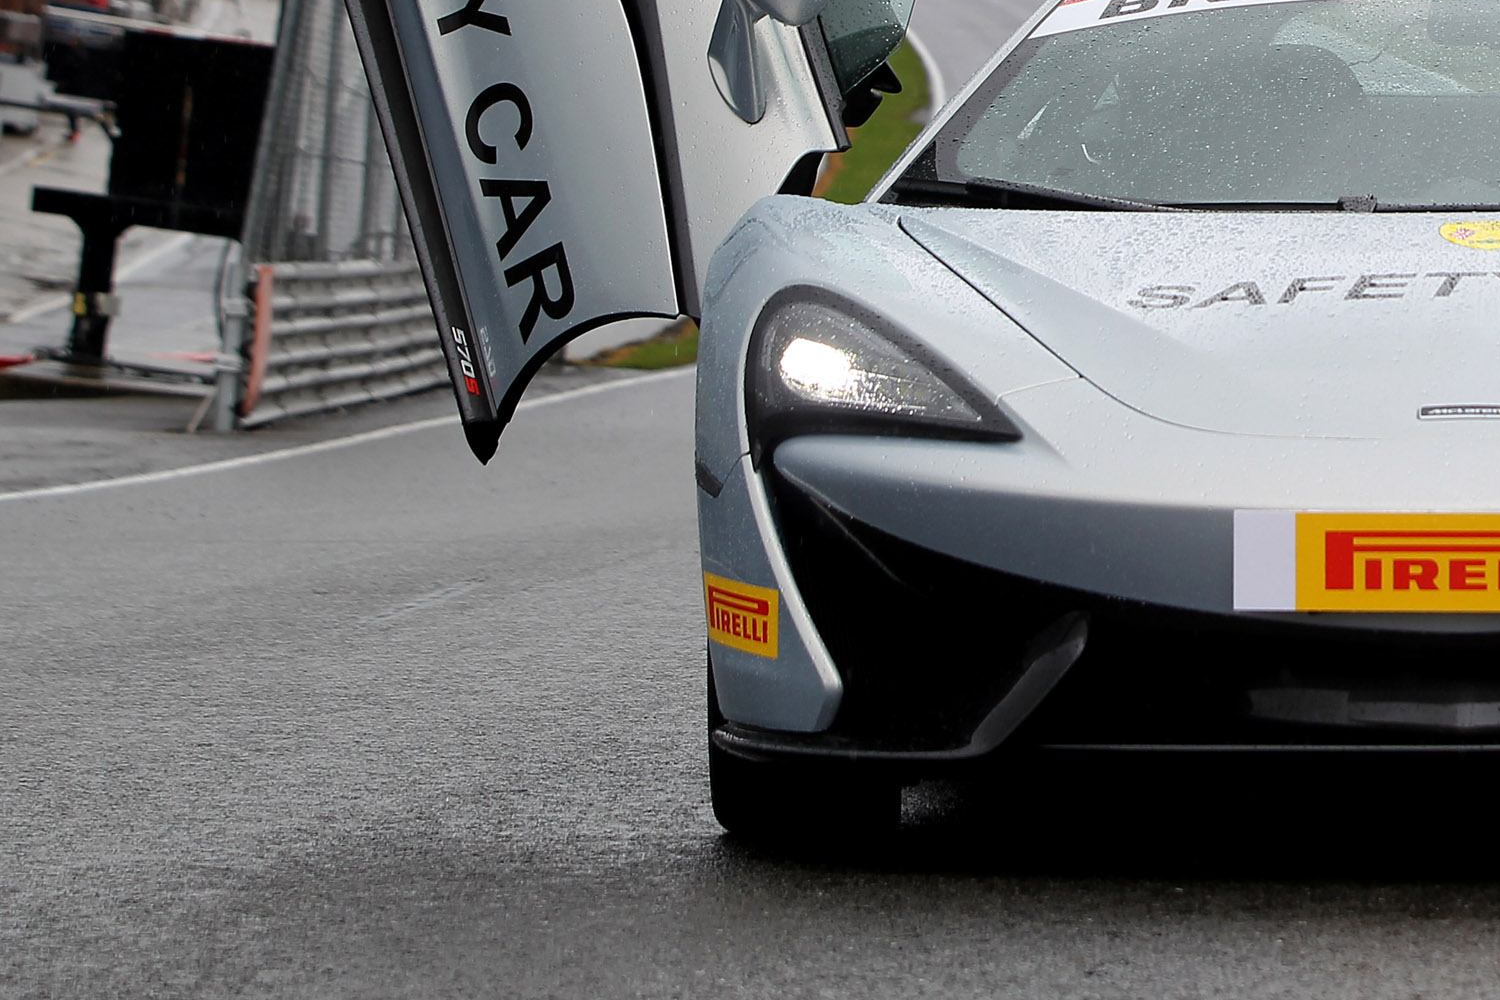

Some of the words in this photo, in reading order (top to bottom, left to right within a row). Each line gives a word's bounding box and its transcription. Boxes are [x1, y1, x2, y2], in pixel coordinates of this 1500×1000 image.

[465, 83, 574, 346] CAR
[452, 326, 480, 396] 570S
[708, 585, 769, 644] PIRELLI
